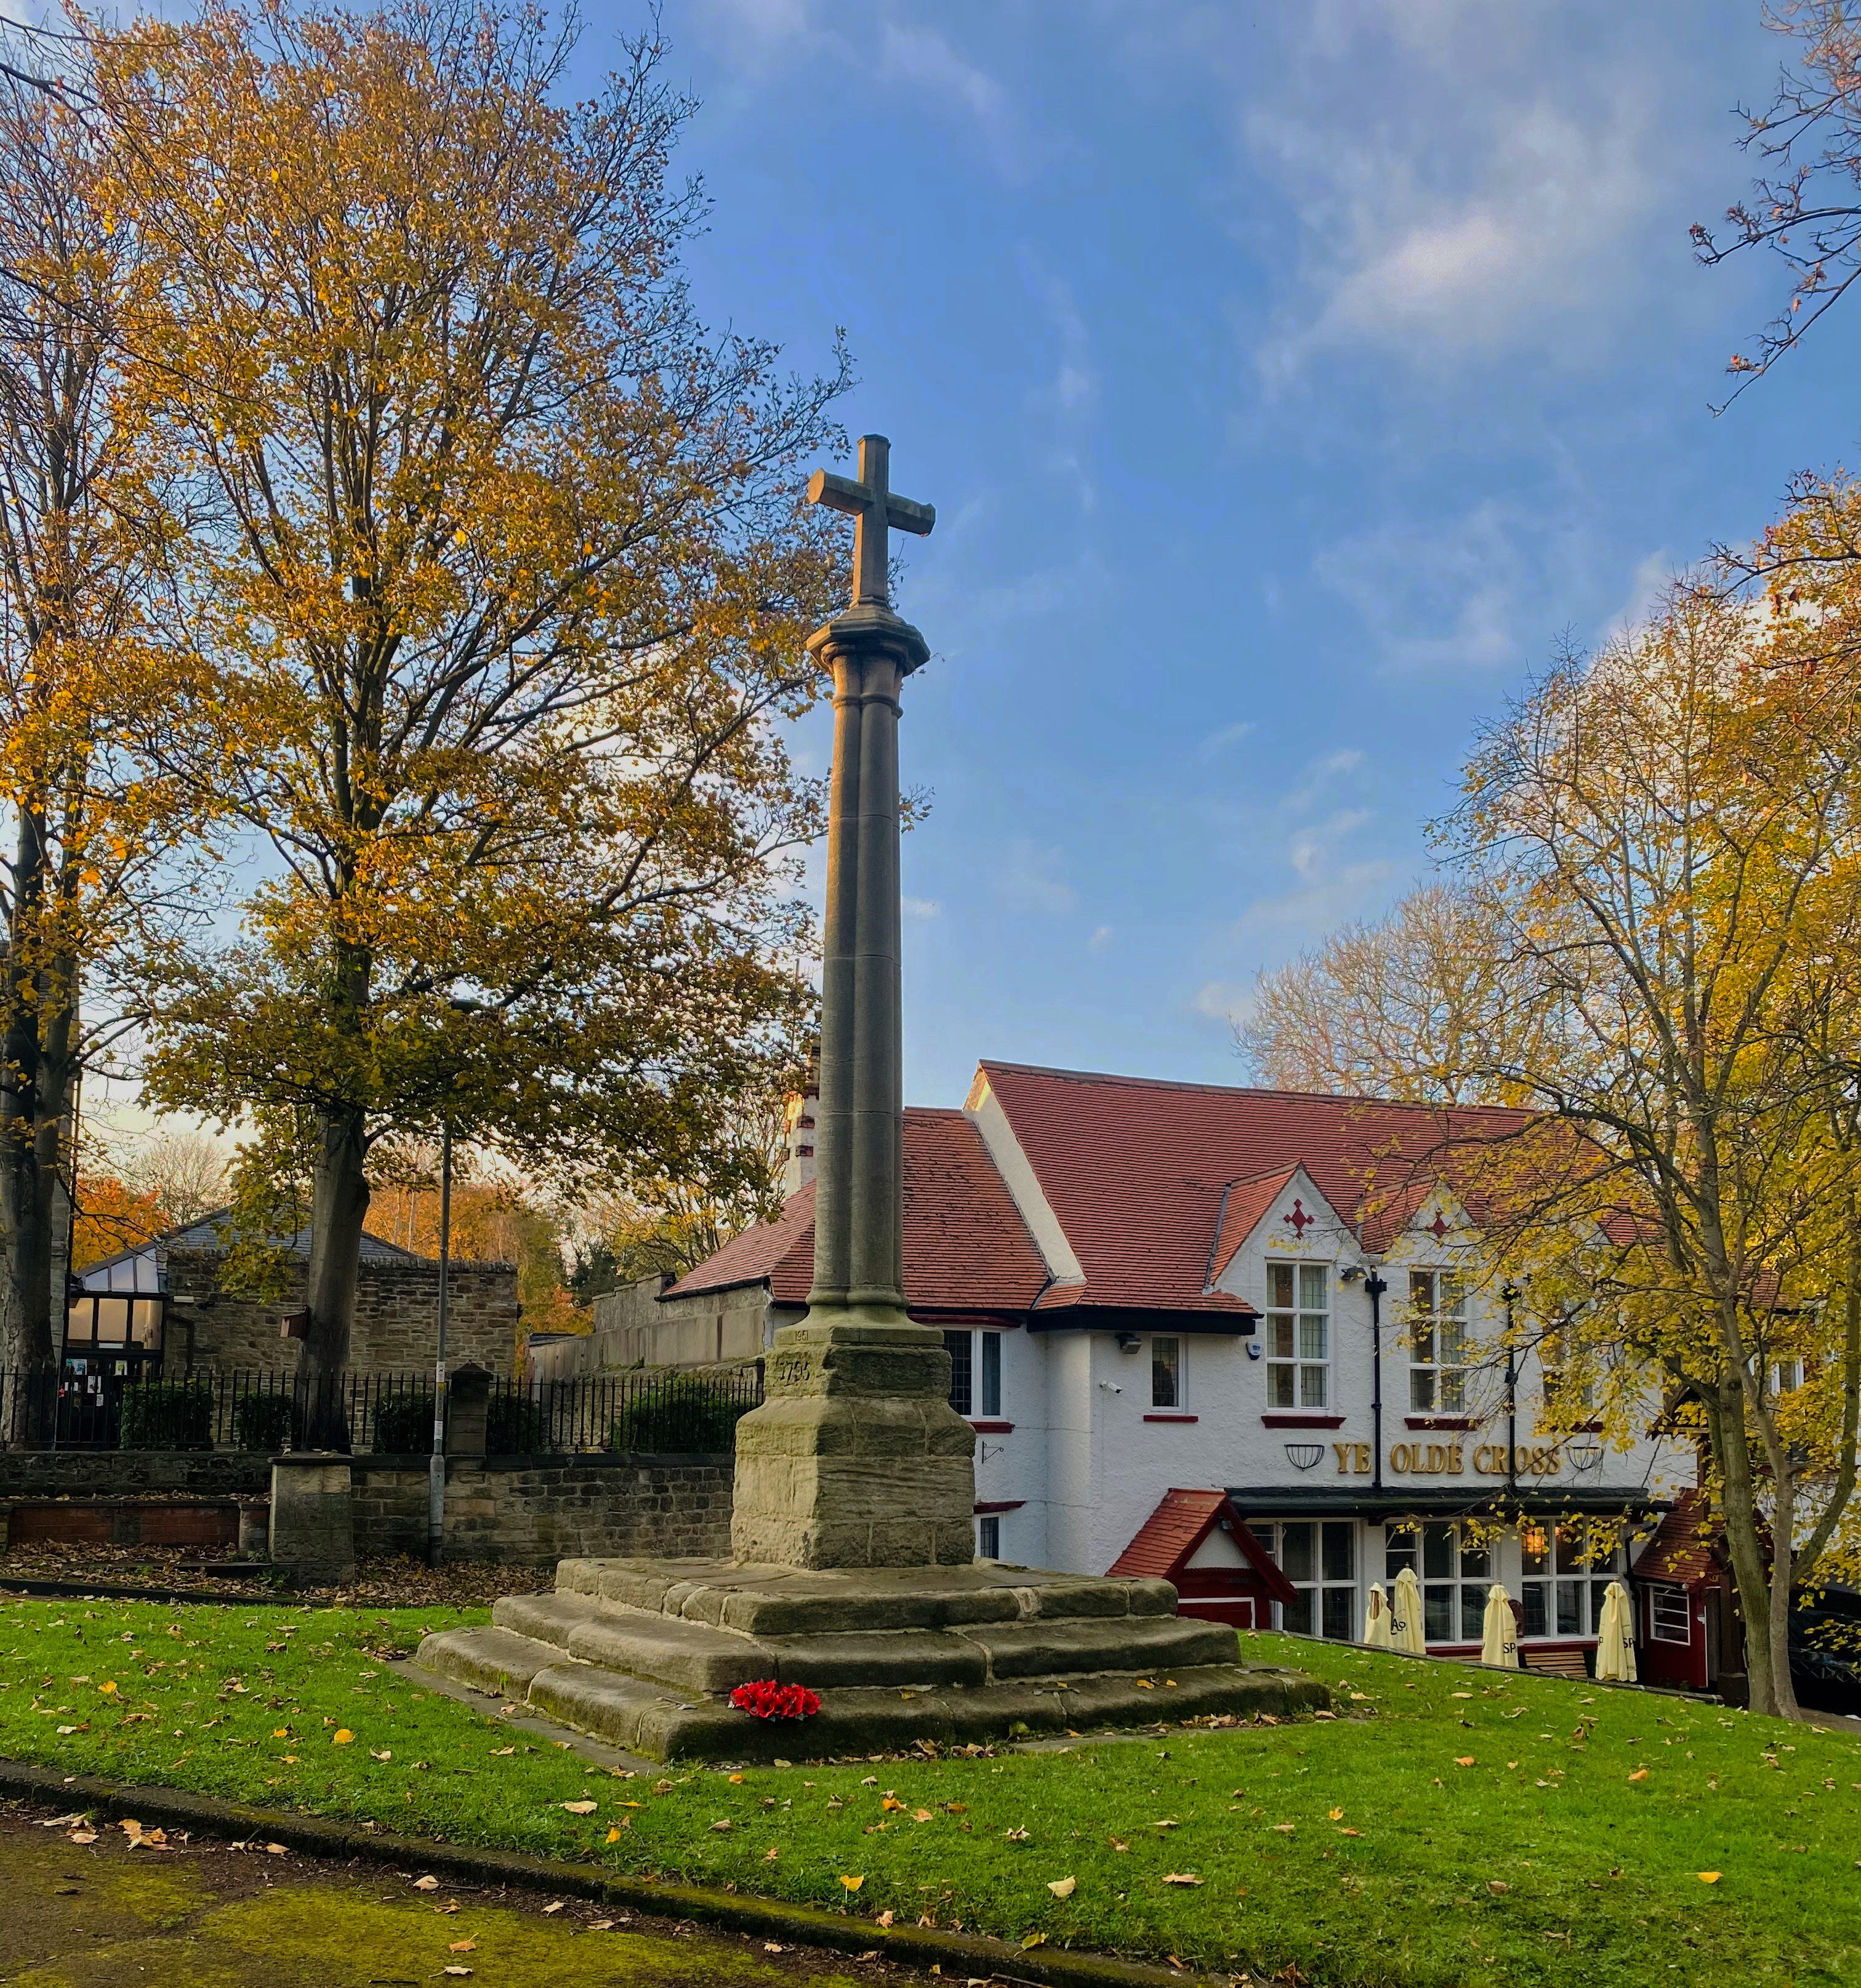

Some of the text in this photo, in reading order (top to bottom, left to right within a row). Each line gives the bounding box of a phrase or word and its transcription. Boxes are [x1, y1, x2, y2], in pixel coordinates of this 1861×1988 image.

[795, 1330, 809, 1342] 1951
[1333, 1443, 1561, 1476] YE OLDE CROSS
